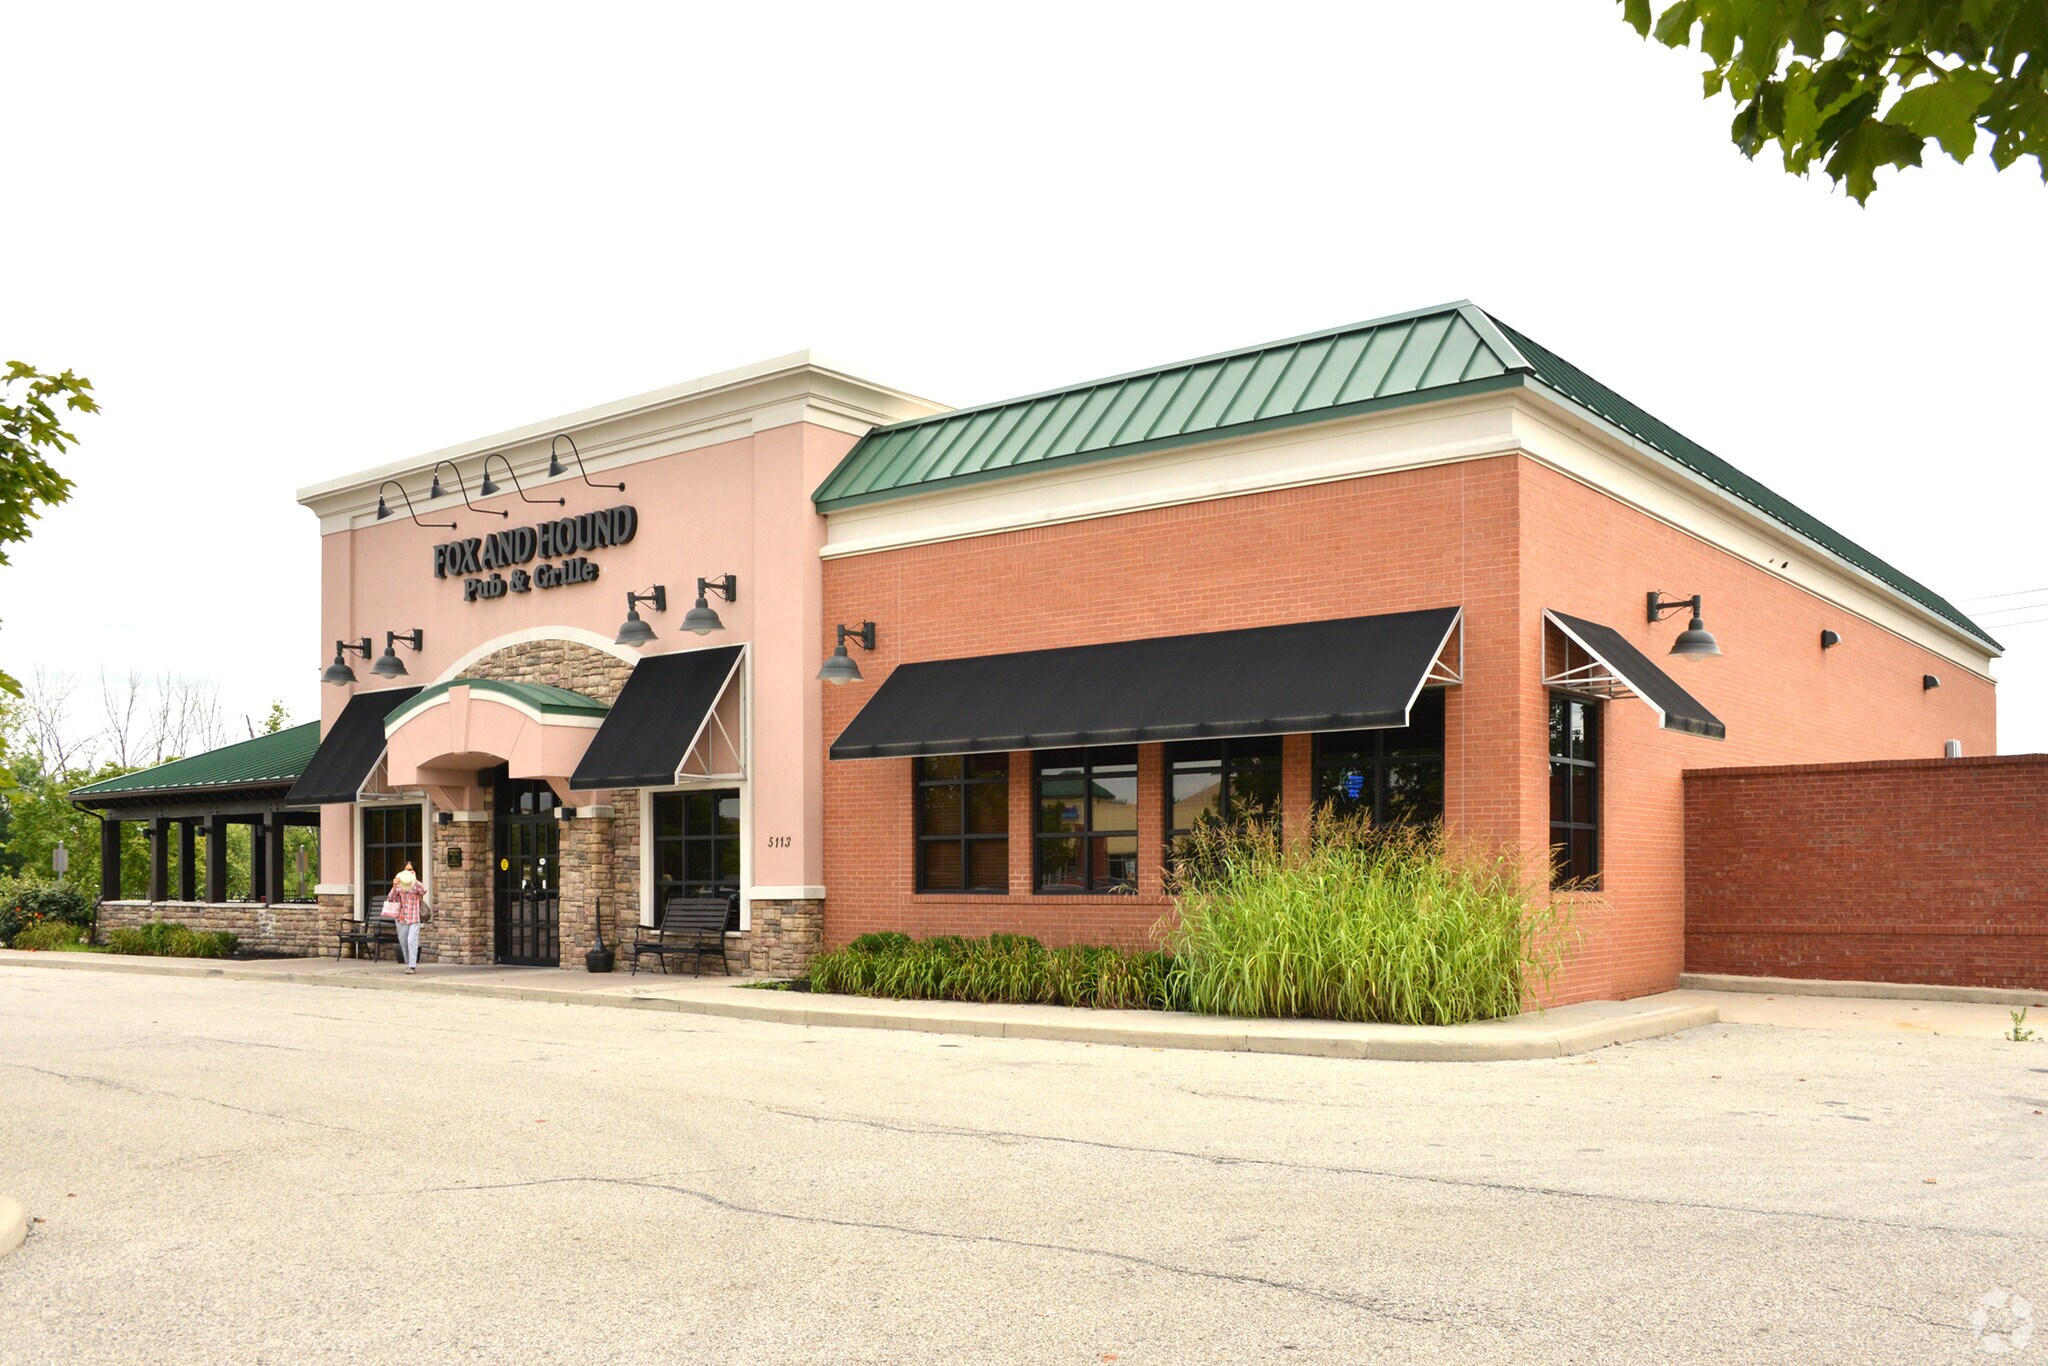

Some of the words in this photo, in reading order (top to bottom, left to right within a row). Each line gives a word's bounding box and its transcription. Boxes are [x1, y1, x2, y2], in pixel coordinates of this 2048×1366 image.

[433, 538, 482, 579] FOX
[481, 526, 537, 570] AND
[537, 505, 638, 559] HOUND
[464, 573, 507, 601] Pub
[510, 569, 532, 593] &
[533, 557, 599, 589] Grille
[768, 836, 791, 848] 5113
